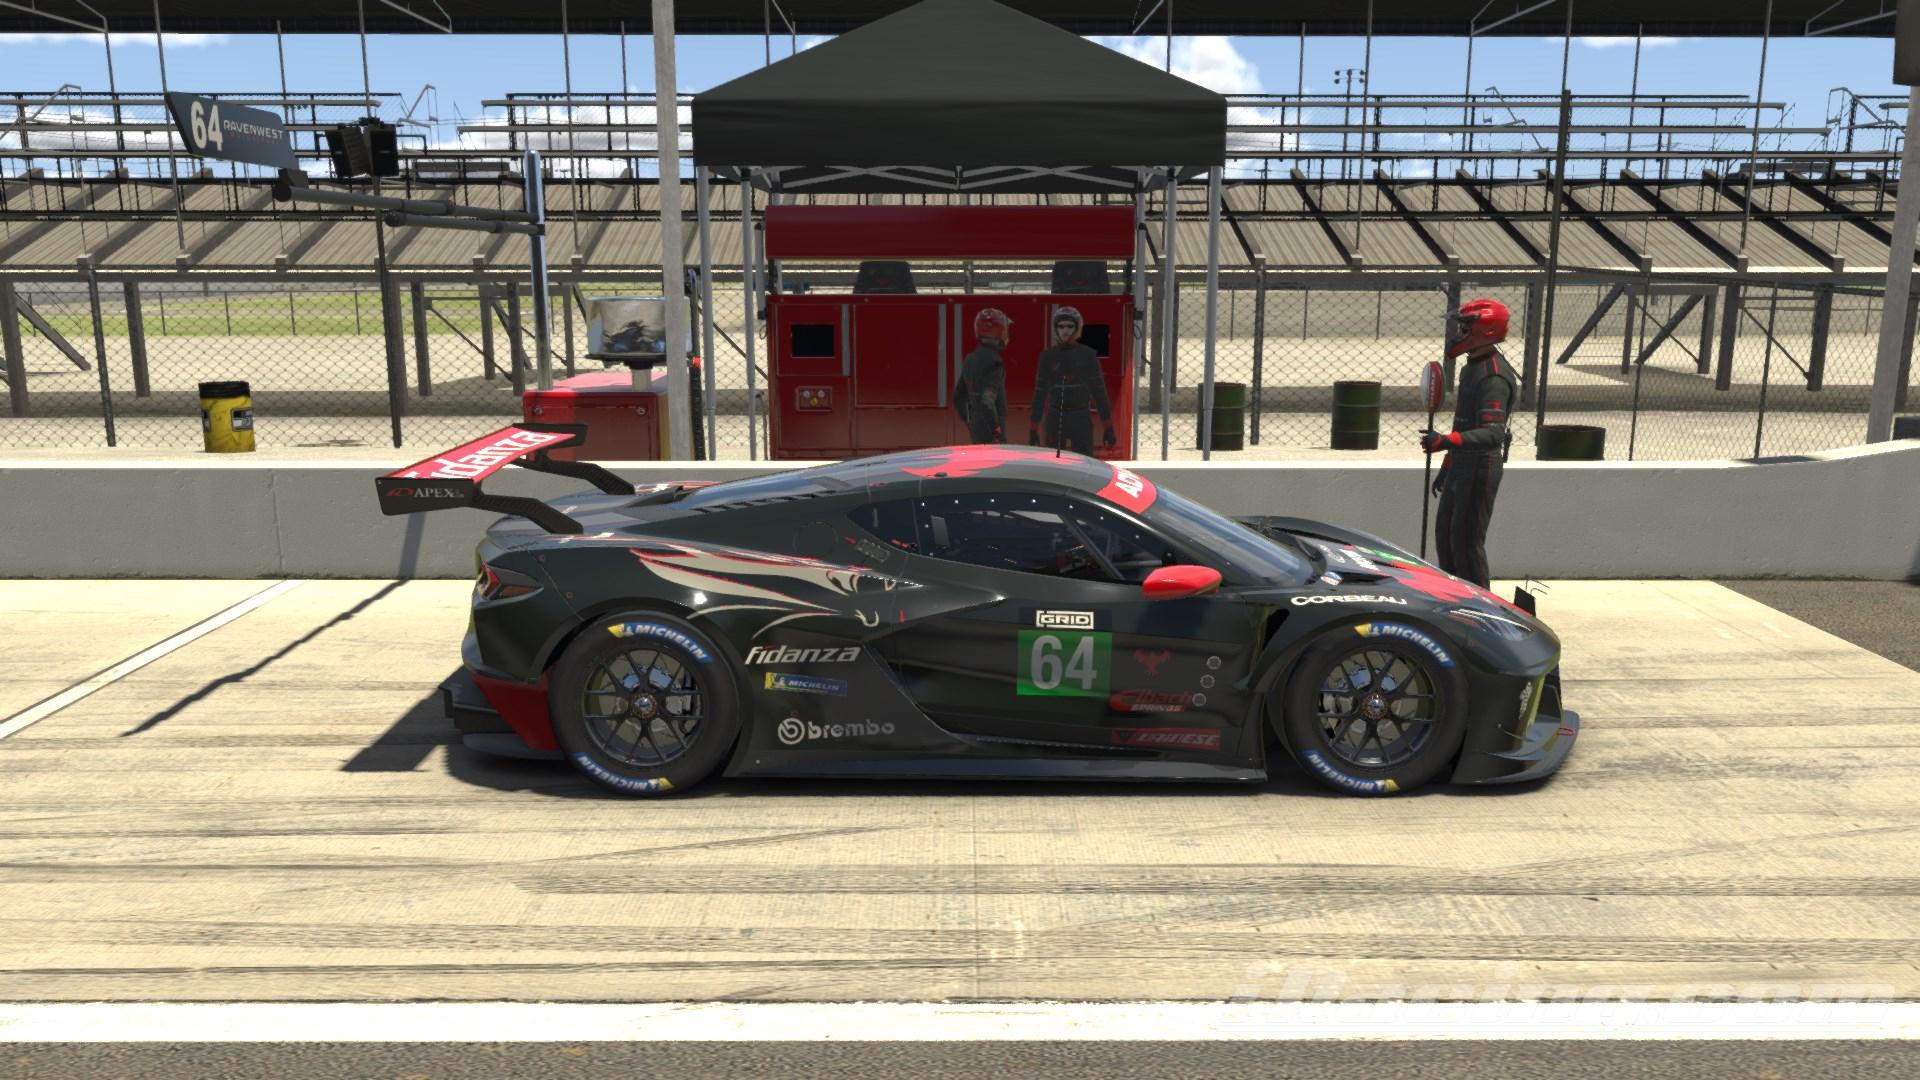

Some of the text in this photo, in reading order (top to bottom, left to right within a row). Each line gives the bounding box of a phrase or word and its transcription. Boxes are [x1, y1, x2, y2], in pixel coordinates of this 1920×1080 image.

[190, 100, 284, 151] 64 RAVENWEST
[413, 487, 454, 499] APEX
[1290, 594, 1408, 606] CORBEAU
[1040, 613, 1091, 626] GRID
[635, 624, 708, 660] MICHELIN
[744, 645, 861, 666] fidanza
[1382, 624, 1450, 664] MICHELIN
[1031, 634, 1097, 690] 64
[788, 679, 841, 692] MICHELIN
[808, 718, 896, 740] brembo
[578, 756, 650, 791] MICHELIN
[1308, 753, 1375, 791] MICHELIN
